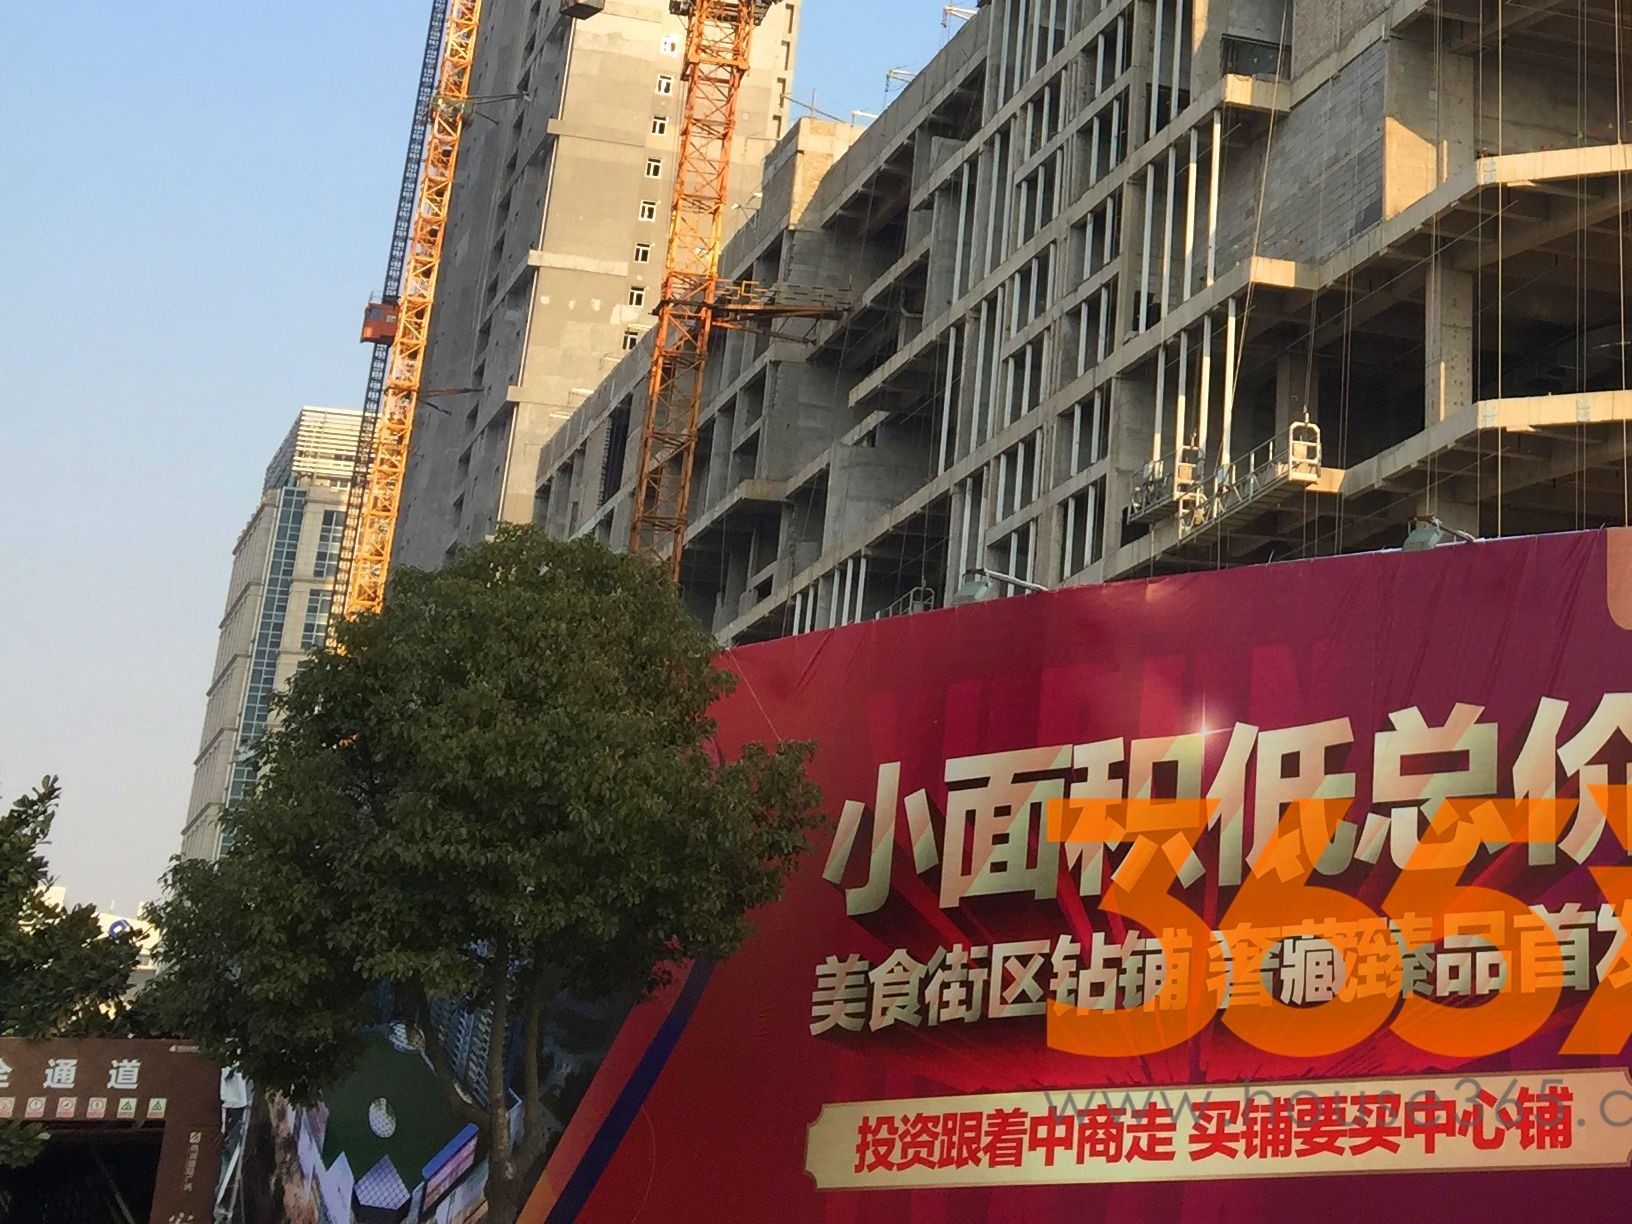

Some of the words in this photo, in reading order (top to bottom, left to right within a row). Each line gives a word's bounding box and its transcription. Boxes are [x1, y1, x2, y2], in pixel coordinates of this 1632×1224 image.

[810, 929, 1191, 1036] 美食街区钻铺
[854, 1100, 1177, 1173] 投资跟着中商走
[1189, 1084, 1573, 1161] 买铺要买中心铺
